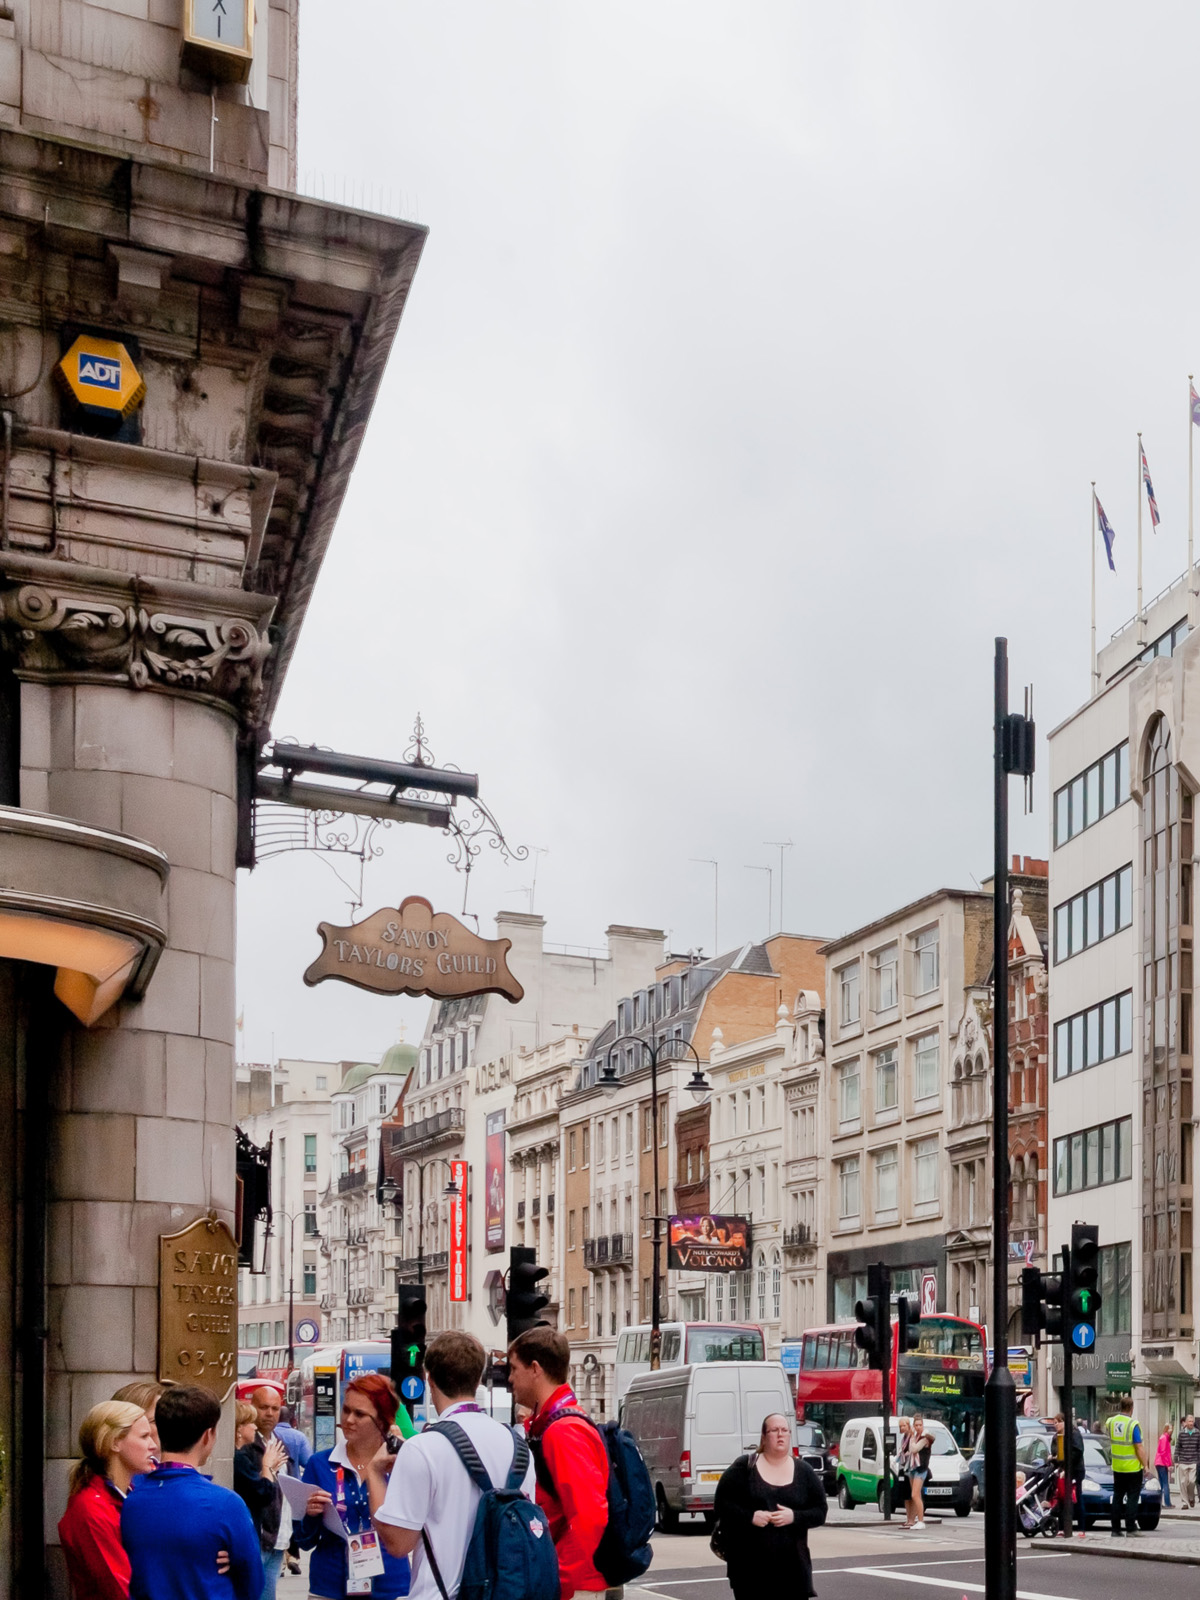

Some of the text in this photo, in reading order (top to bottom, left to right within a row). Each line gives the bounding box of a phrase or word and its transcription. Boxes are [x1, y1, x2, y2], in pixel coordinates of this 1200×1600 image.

[80, 361, 121, 384] ADT
[676, 1249, 744, 1267] VOLCANO
[455, 1250, 463, 1299] TODD
[348, 1355, 363, 1367] I'll
[348, 1368, 377, 1381] give
[949, 1375, 956, 1384] 11
[921, 1385, 944, 1394] Liverpool
